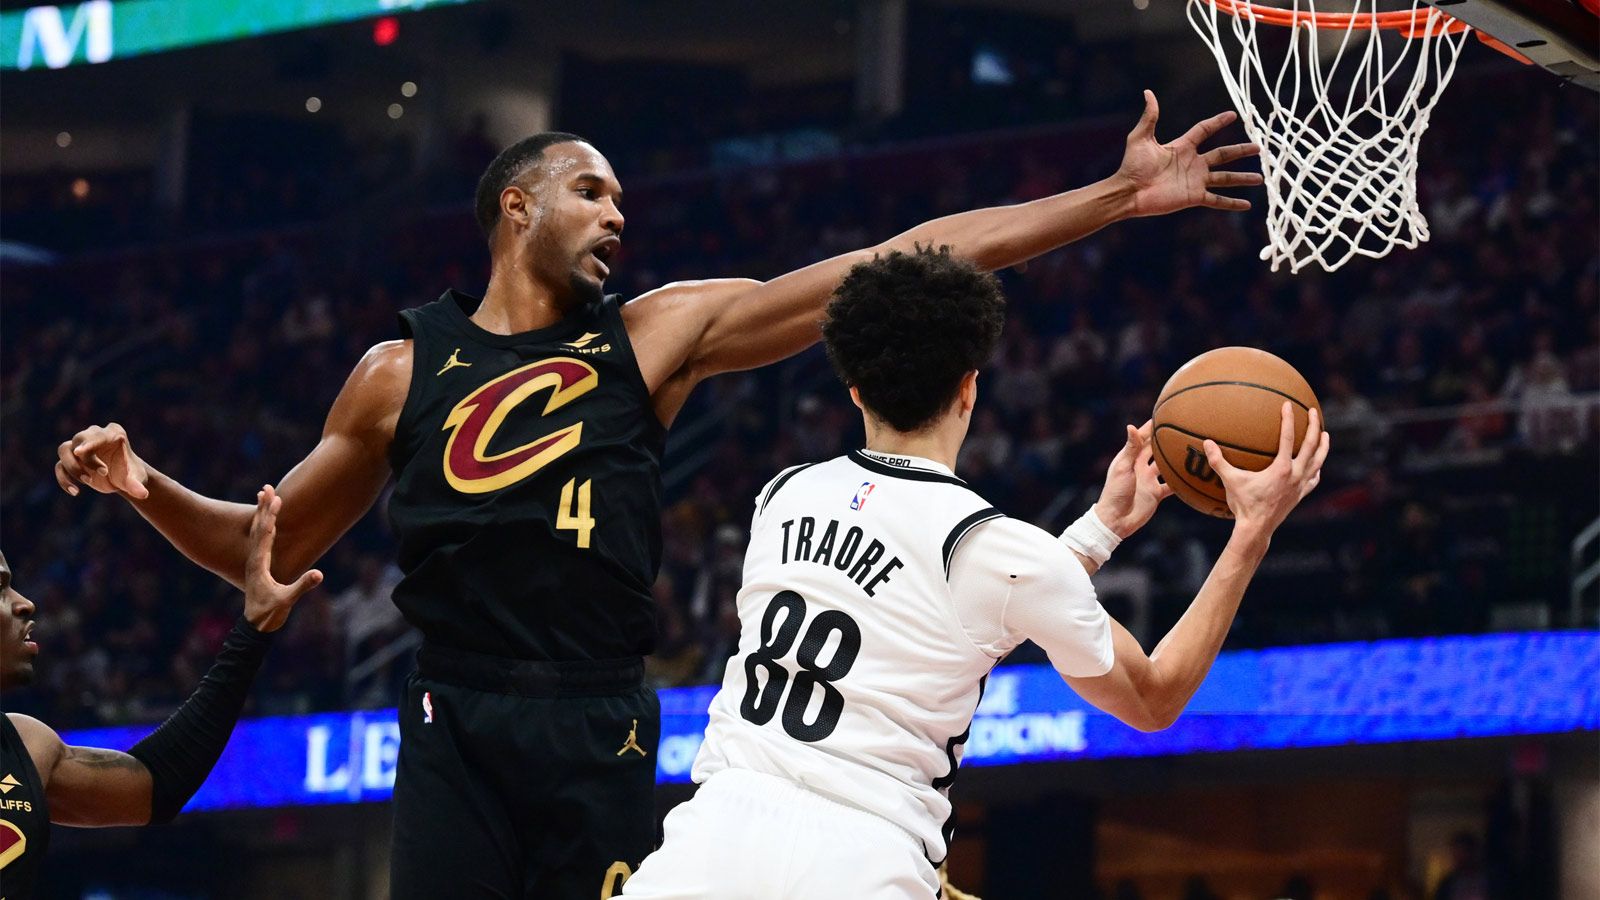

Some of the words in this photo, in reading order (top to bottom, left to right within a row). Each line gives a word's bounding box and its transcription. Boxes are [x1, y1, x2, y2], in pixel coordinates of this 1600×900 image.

[441, 356, 599, 494] C
[555, 477, 595, 548] 4
[781, 516, 904, 598] TRAORE
[740, 589, 862, 742] 88
